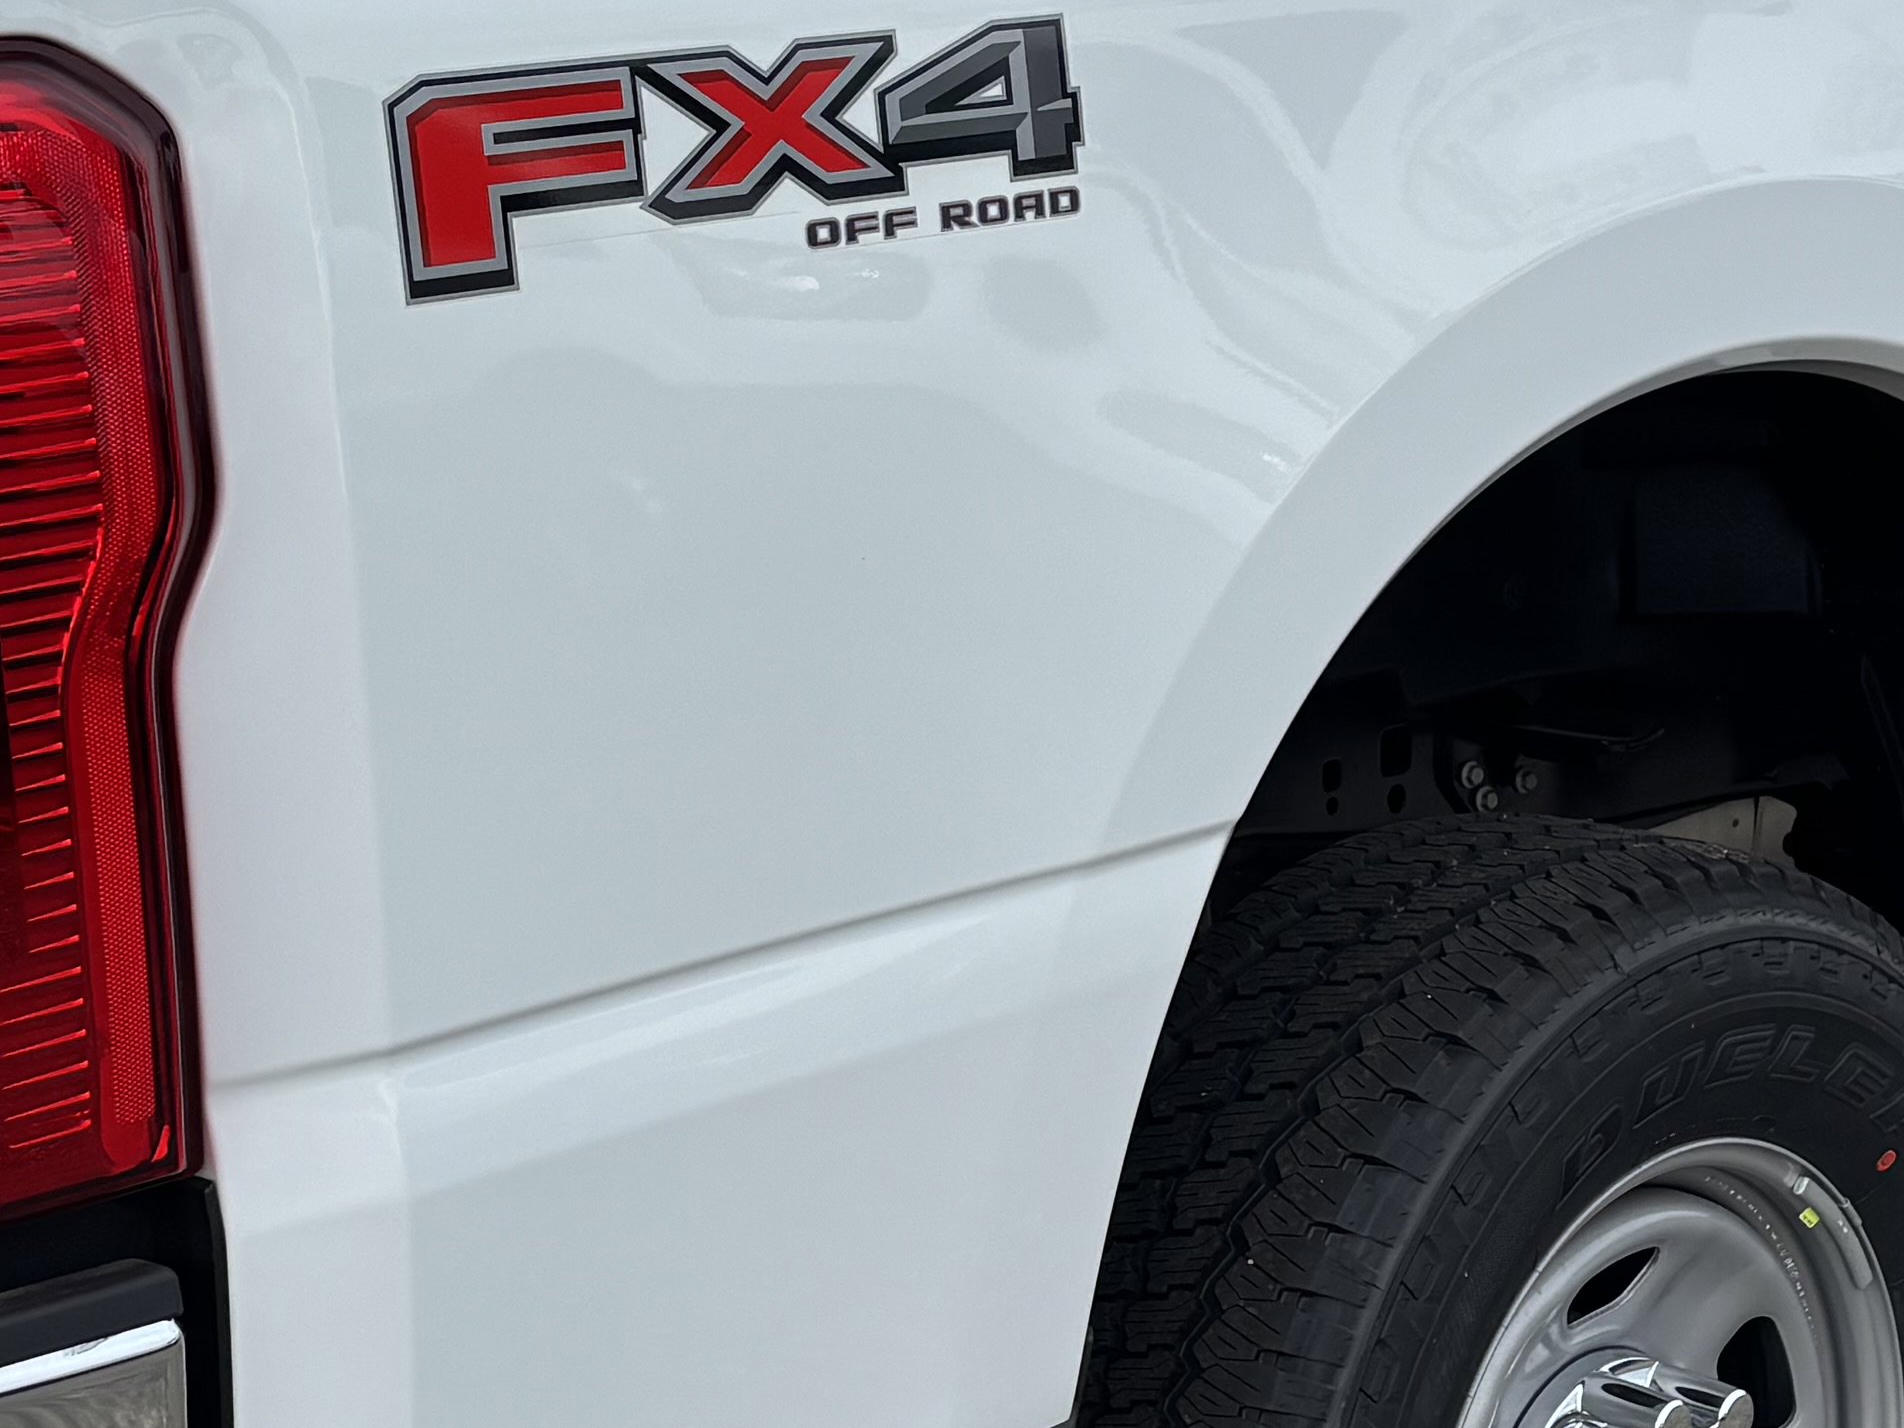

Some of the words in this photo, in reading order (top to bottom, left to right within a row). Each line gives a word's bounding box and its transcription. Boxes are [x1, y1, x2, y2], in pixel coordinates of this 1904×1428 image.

[383, 12, 1086, 307] FX4
[805, 204, 920, 251] OFF
[939, 185, 1081, 234] ROAD
